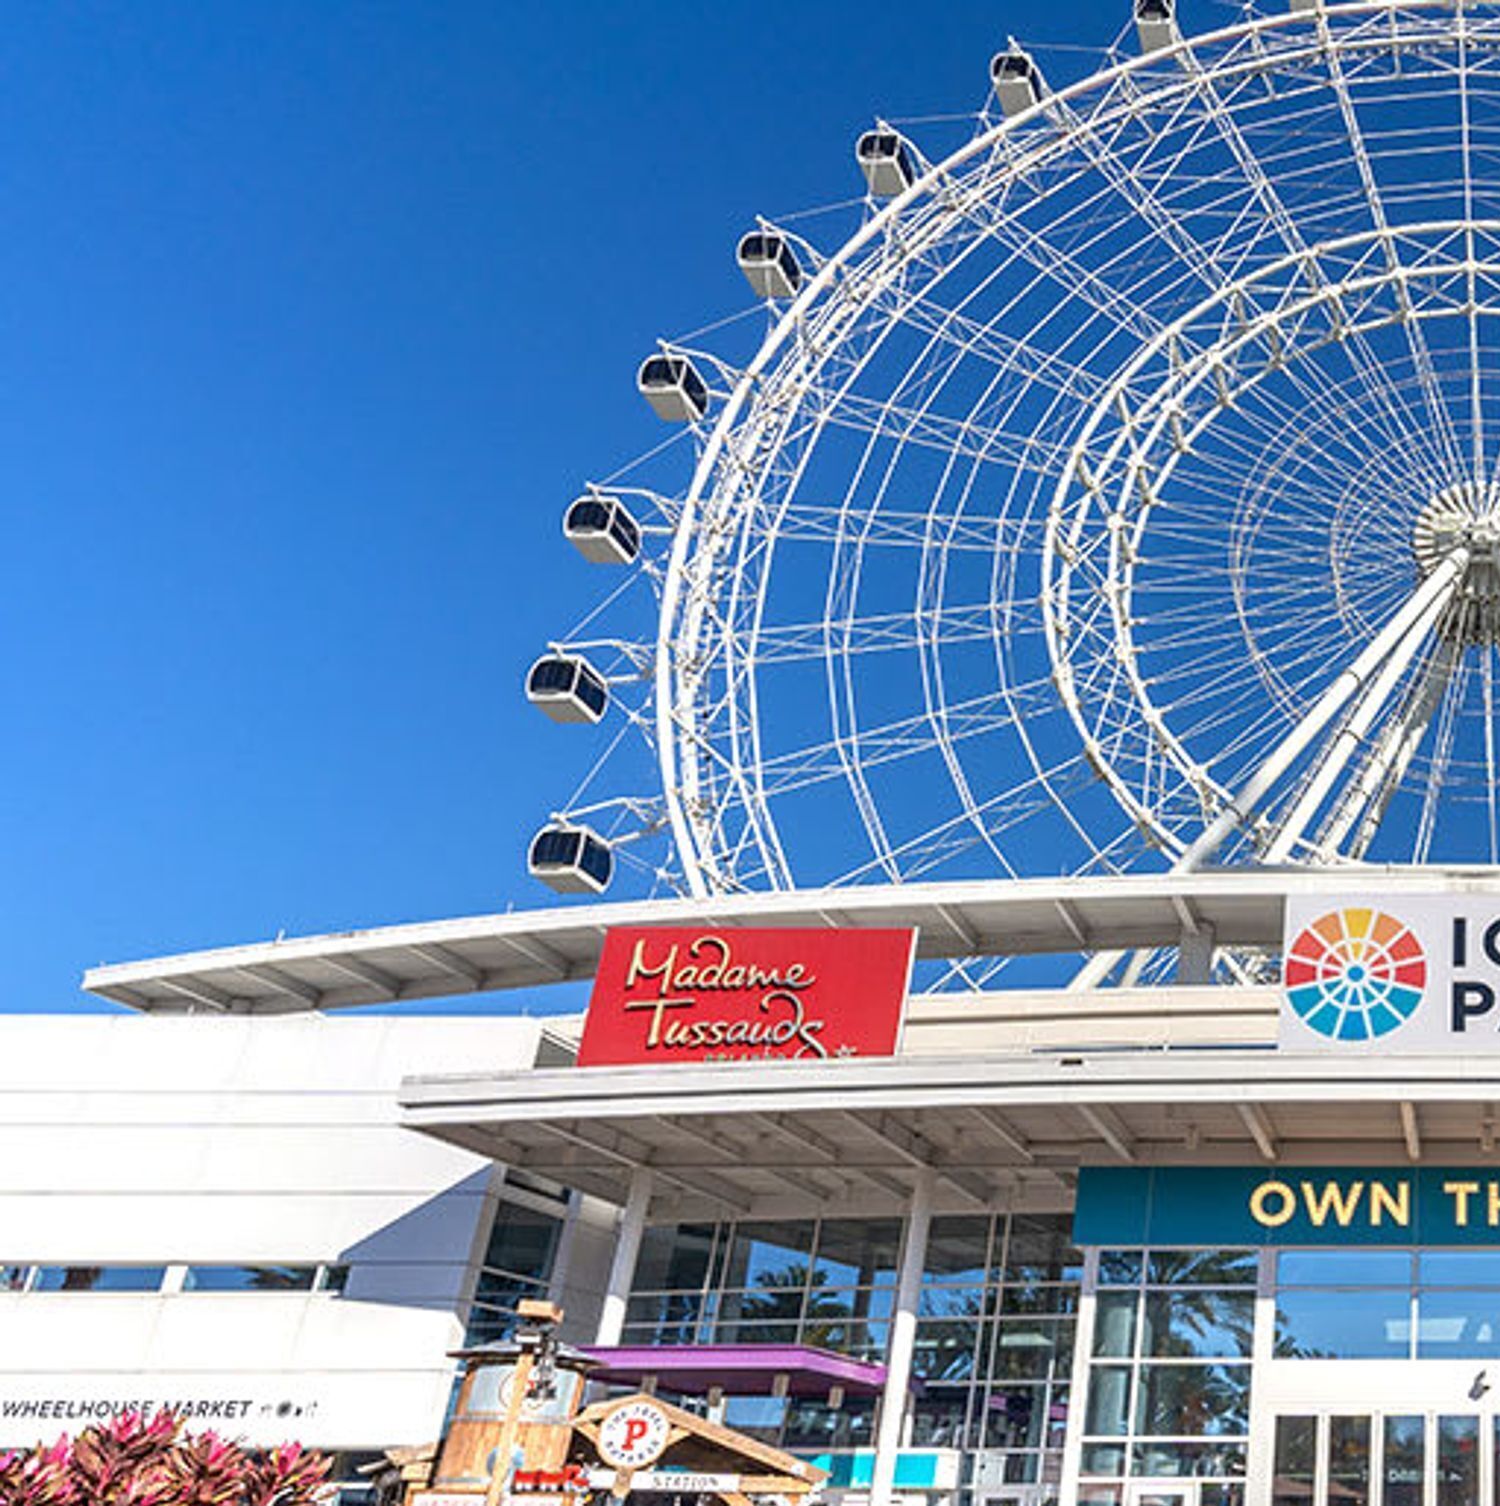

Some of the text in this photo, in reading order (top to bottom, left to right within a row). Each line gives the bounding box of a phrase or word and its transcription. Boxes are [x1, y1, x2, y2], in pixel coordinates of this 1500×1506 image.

[625, 936, 815, 996] Madame
[625, 991, 827, 1060] Tussauds
[1250, 1180, 1410, 1227] OWN
[2, 1400, 154, 1420] WHEELHOUSE
[621, 1418, 648, 1450] P
